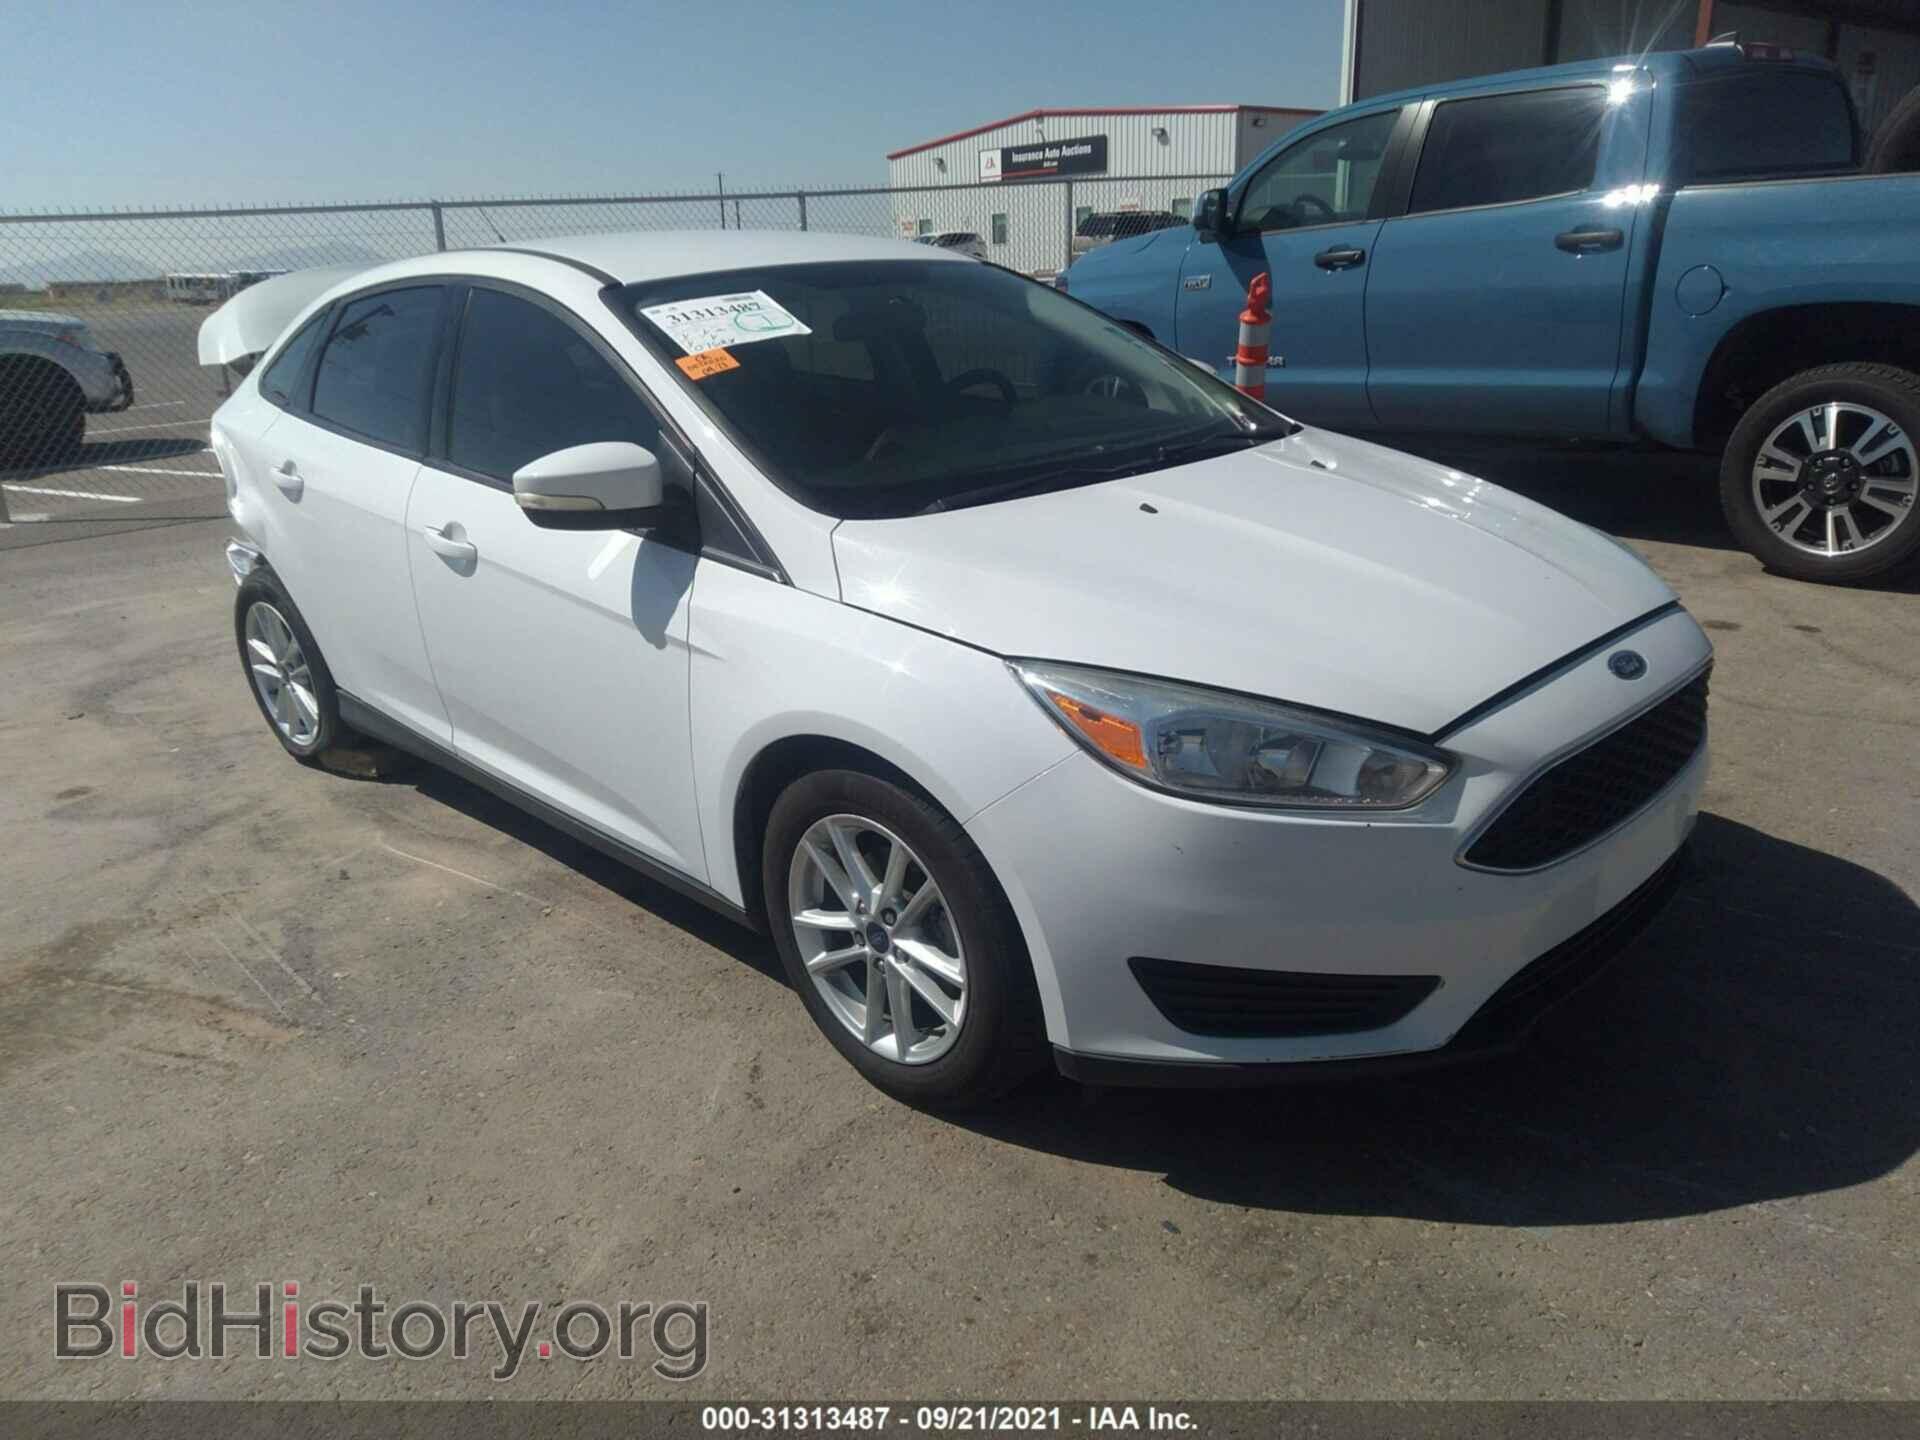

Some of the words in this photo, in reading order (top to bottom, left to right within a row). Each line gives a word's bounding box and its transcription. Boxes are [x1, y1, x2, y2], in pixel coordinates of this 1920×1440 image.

[1012, 151, 1043, 163] Insurance
[1044, 147, 1060, 159] Auto
[1061, 144, 1092, 157] Auctions
